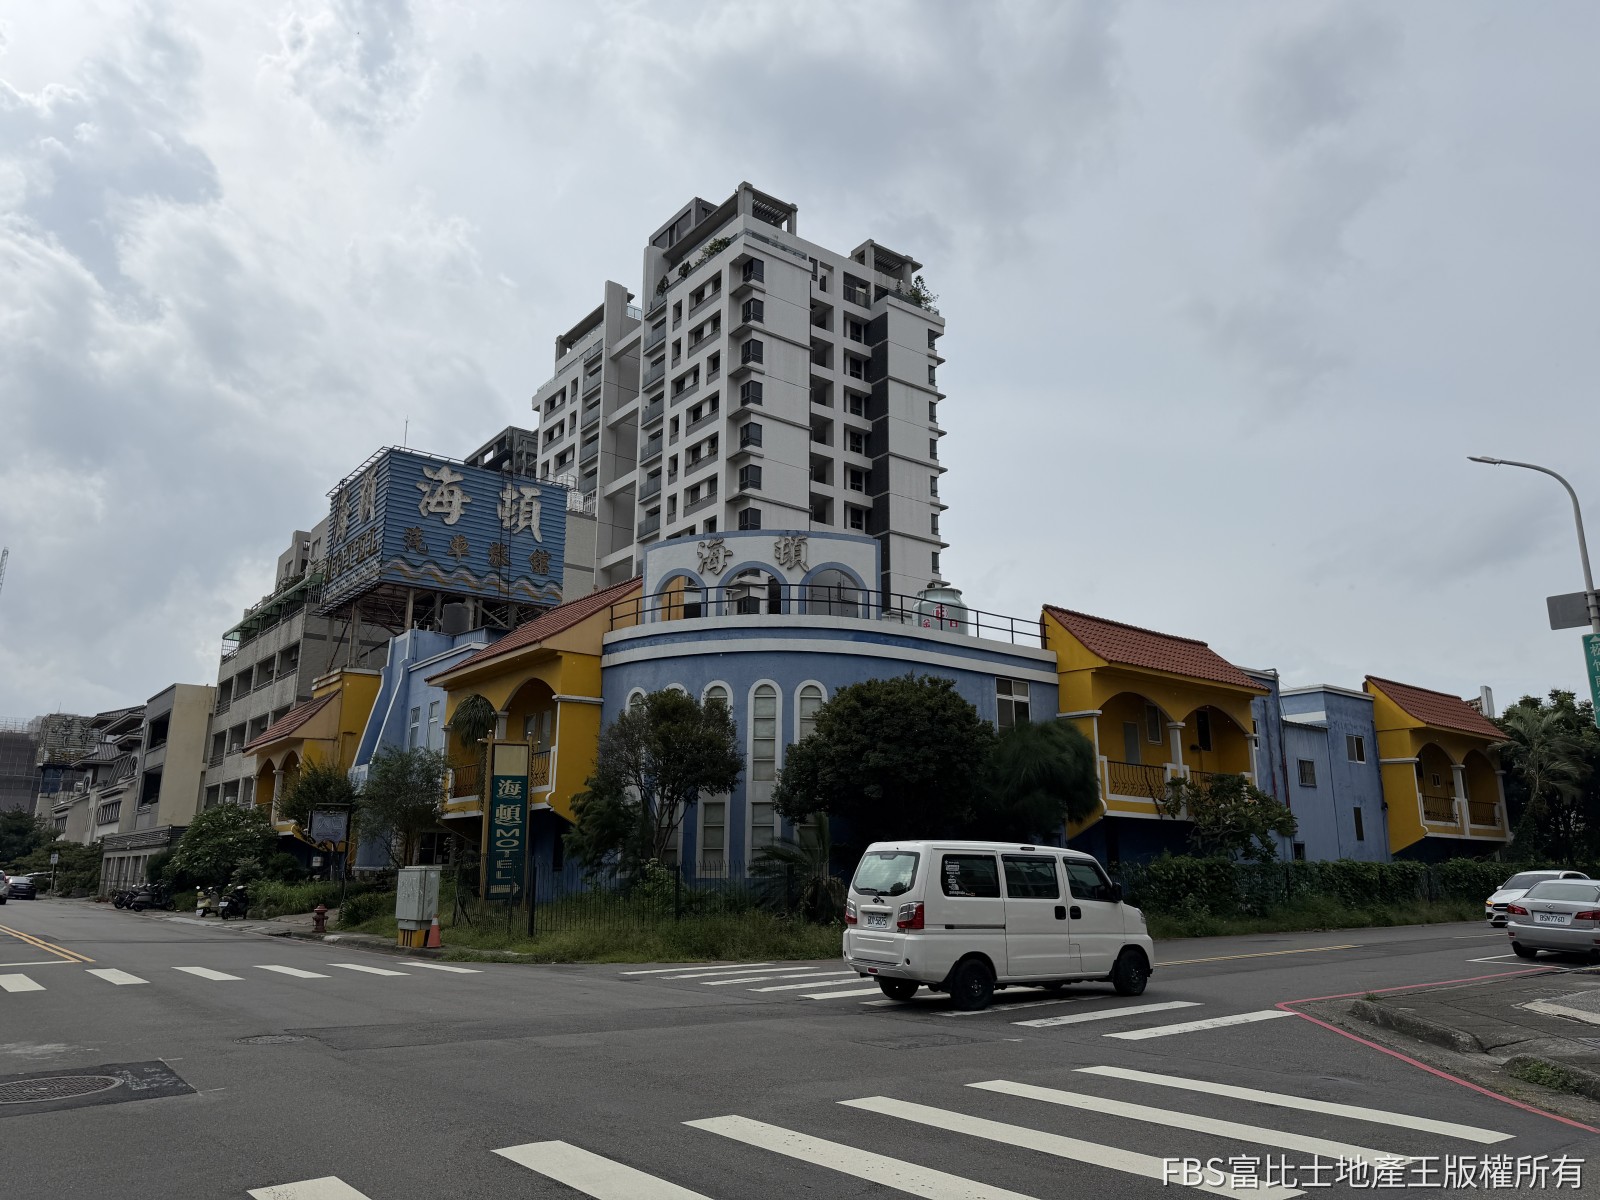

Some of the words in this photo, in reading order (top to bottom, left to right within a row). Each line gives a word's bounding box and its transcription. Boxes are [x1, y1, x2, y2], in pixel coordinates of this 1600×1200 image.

[404, 526, 552, 576] 汽車旅館
[697, 535, 810, 576] 海頓
[494, 779, 523, 825] 海頓
[495, 828, 520, 879] MOTEL
